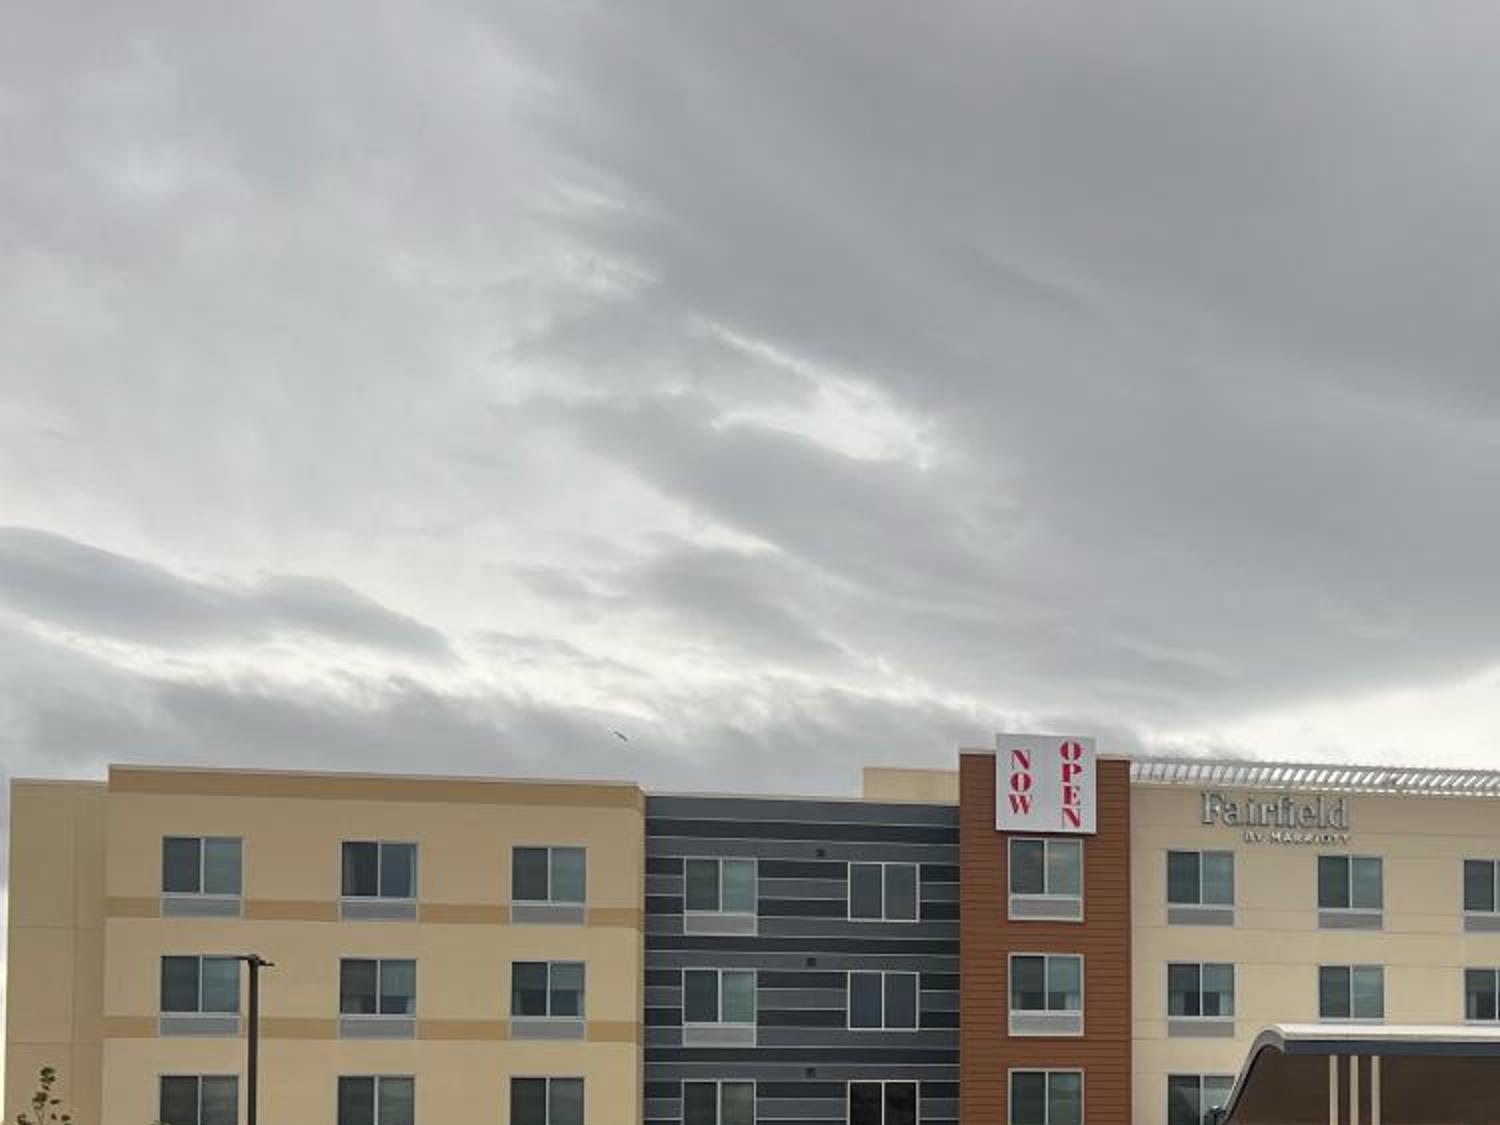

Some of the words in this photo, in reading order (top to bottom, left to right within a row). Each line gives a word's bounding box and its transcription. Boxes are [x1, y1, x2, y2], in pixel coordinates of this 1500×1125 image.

[1008, 749, 1032, 815] NOW
[1060, 741, 1082, 829] OPEN
[1201, 792, 1349, 829] Fairfield
